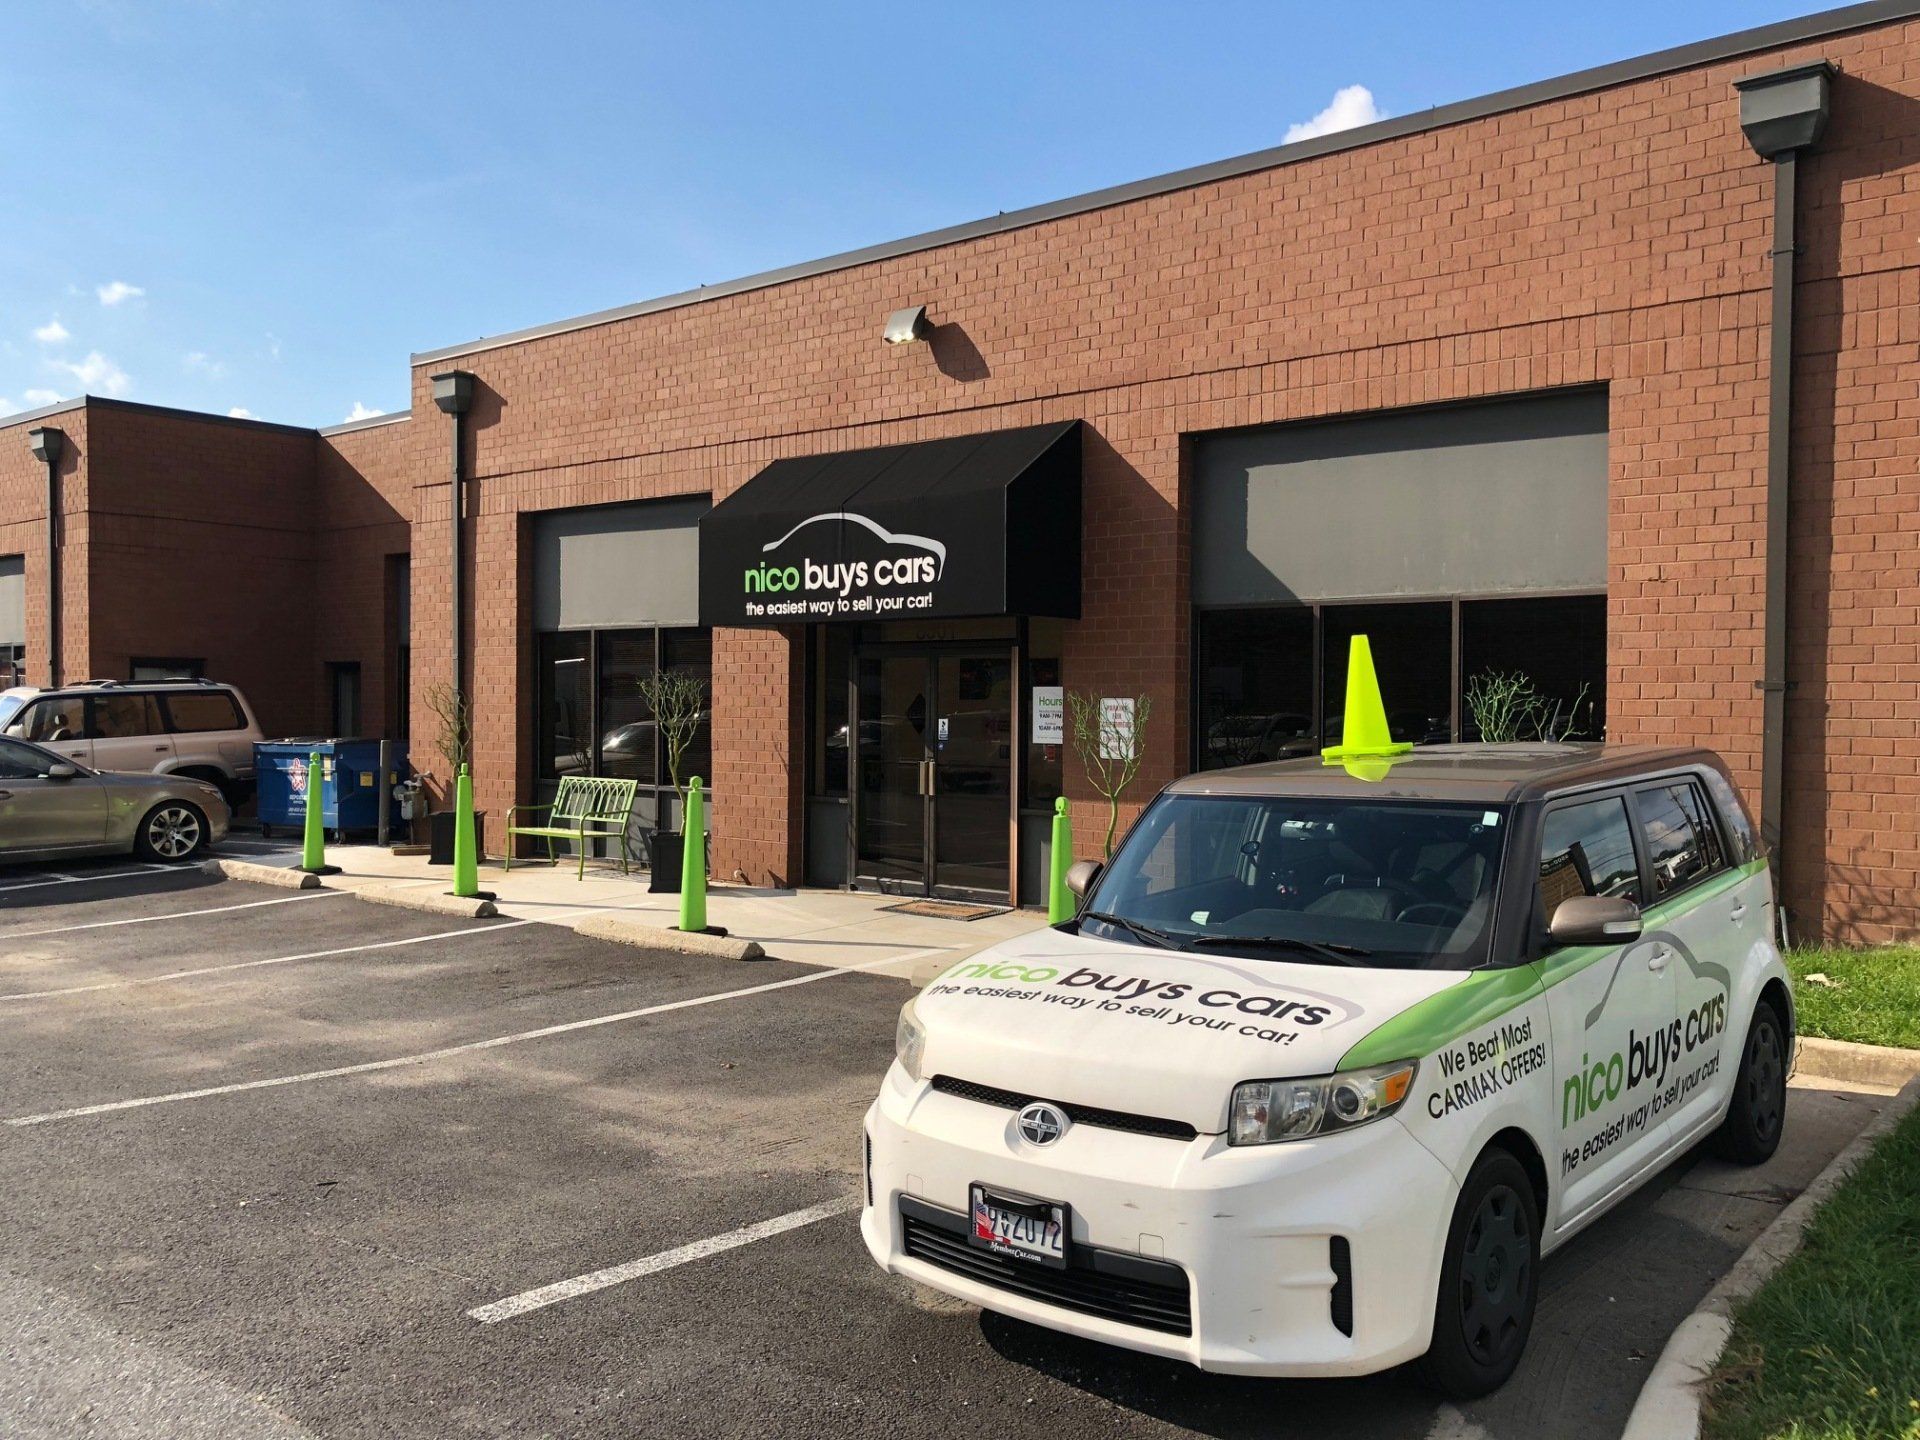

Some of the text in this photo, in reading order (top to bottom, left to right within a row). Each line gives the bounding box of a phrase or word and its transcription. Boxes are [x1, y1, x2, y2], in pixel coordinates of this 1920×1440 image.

[745, 556, 935, 596] nico buys cars
[746, 592, 933, 616] the easiest way to sell your car!
[1039, 696, 1063, 706] Hours
[929, 983, 1300, 1046] the easiest way to sell your car!
[946, 961, 1332, 1026] nico buys cars
[1438, 1016, 1532, 1079] We Beat Most
[1562, 992, 1725, 1129] nico buys cars
[1427, 1043, 1546, 1119] CARMAX OFFERS!
[1561, 1050, 1720, 1179] the easiest way to sell your car!
